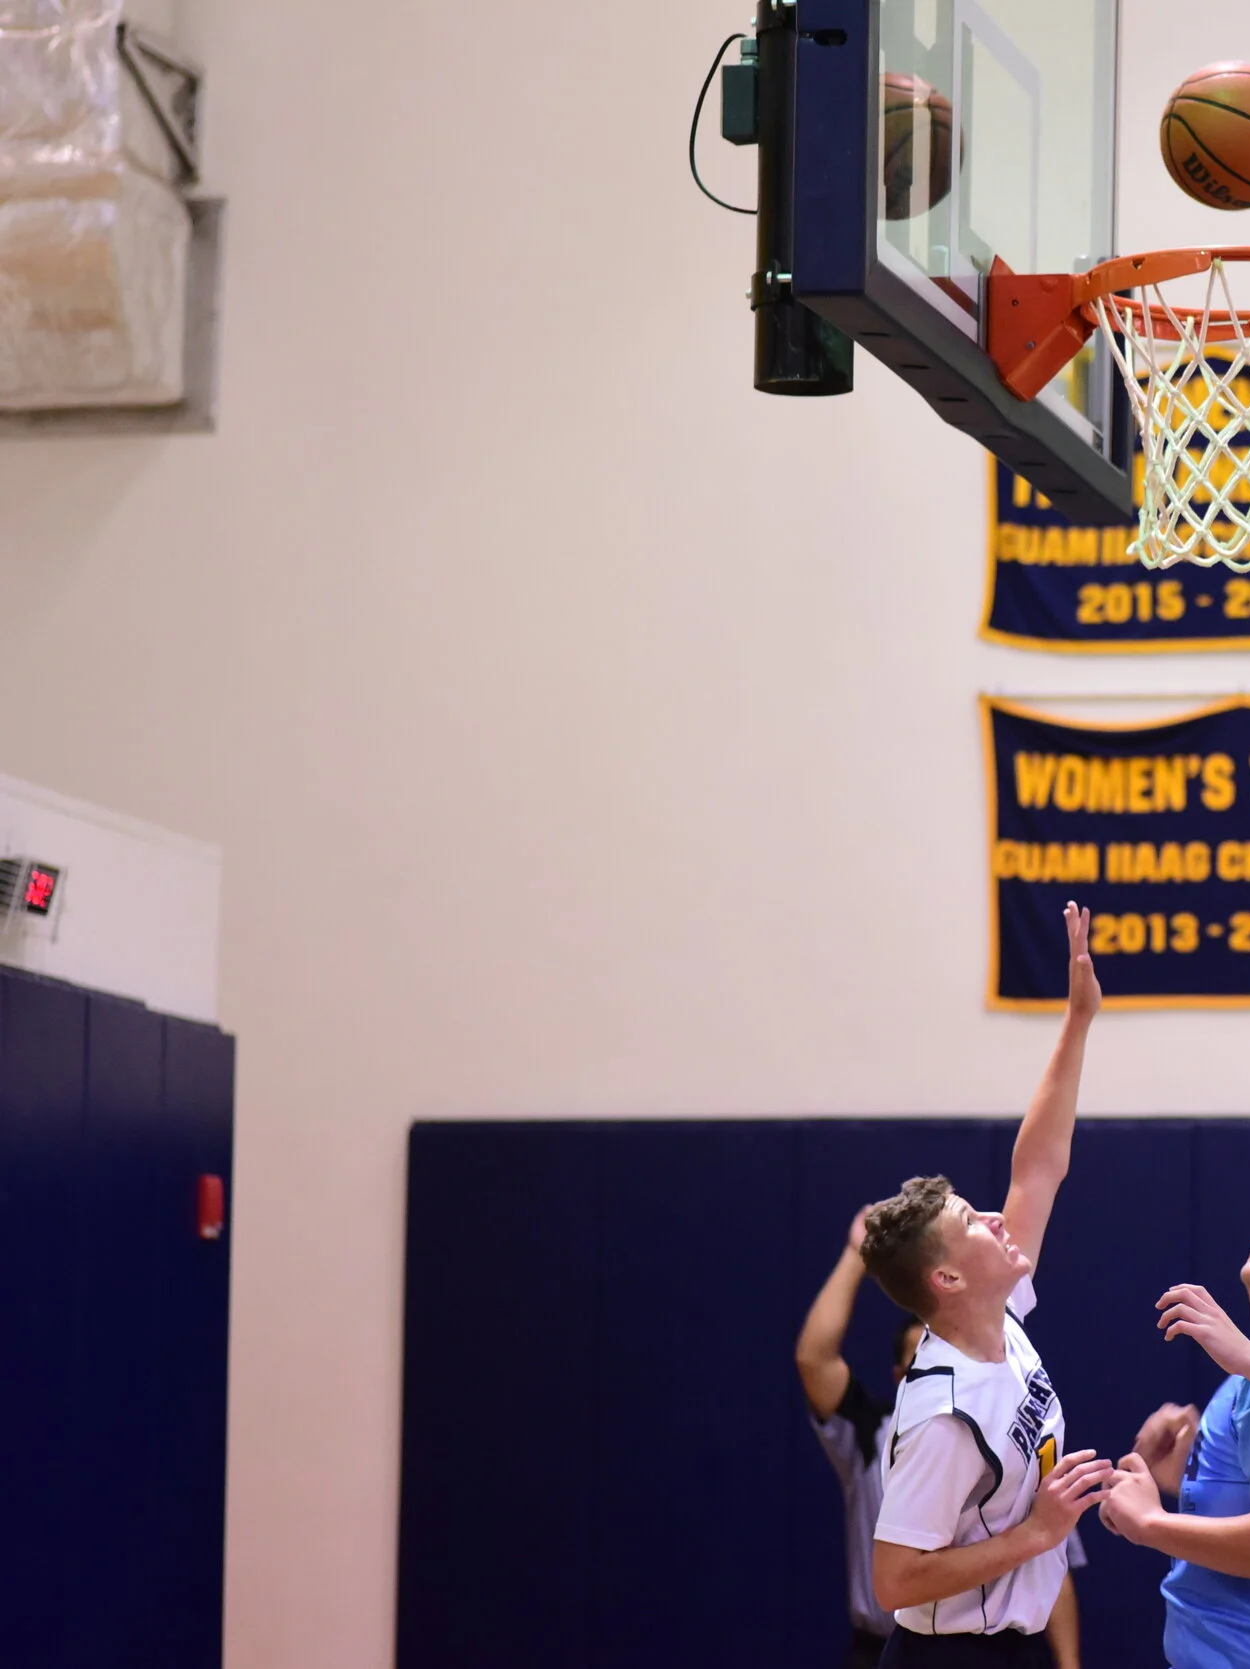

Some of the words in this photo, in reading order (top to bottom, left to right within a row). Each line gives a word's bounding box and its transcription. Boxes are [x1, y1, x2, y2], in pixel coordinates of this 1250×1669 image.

[993, 522, 1100, 567] GUAM
[1077, 581, 1185, 624] 2015
[1015, 752, 1236, 814] WOMEN'S
[993, 837, 1100, 883] GUAM
[1090, 913, 1199, 954] 2013
